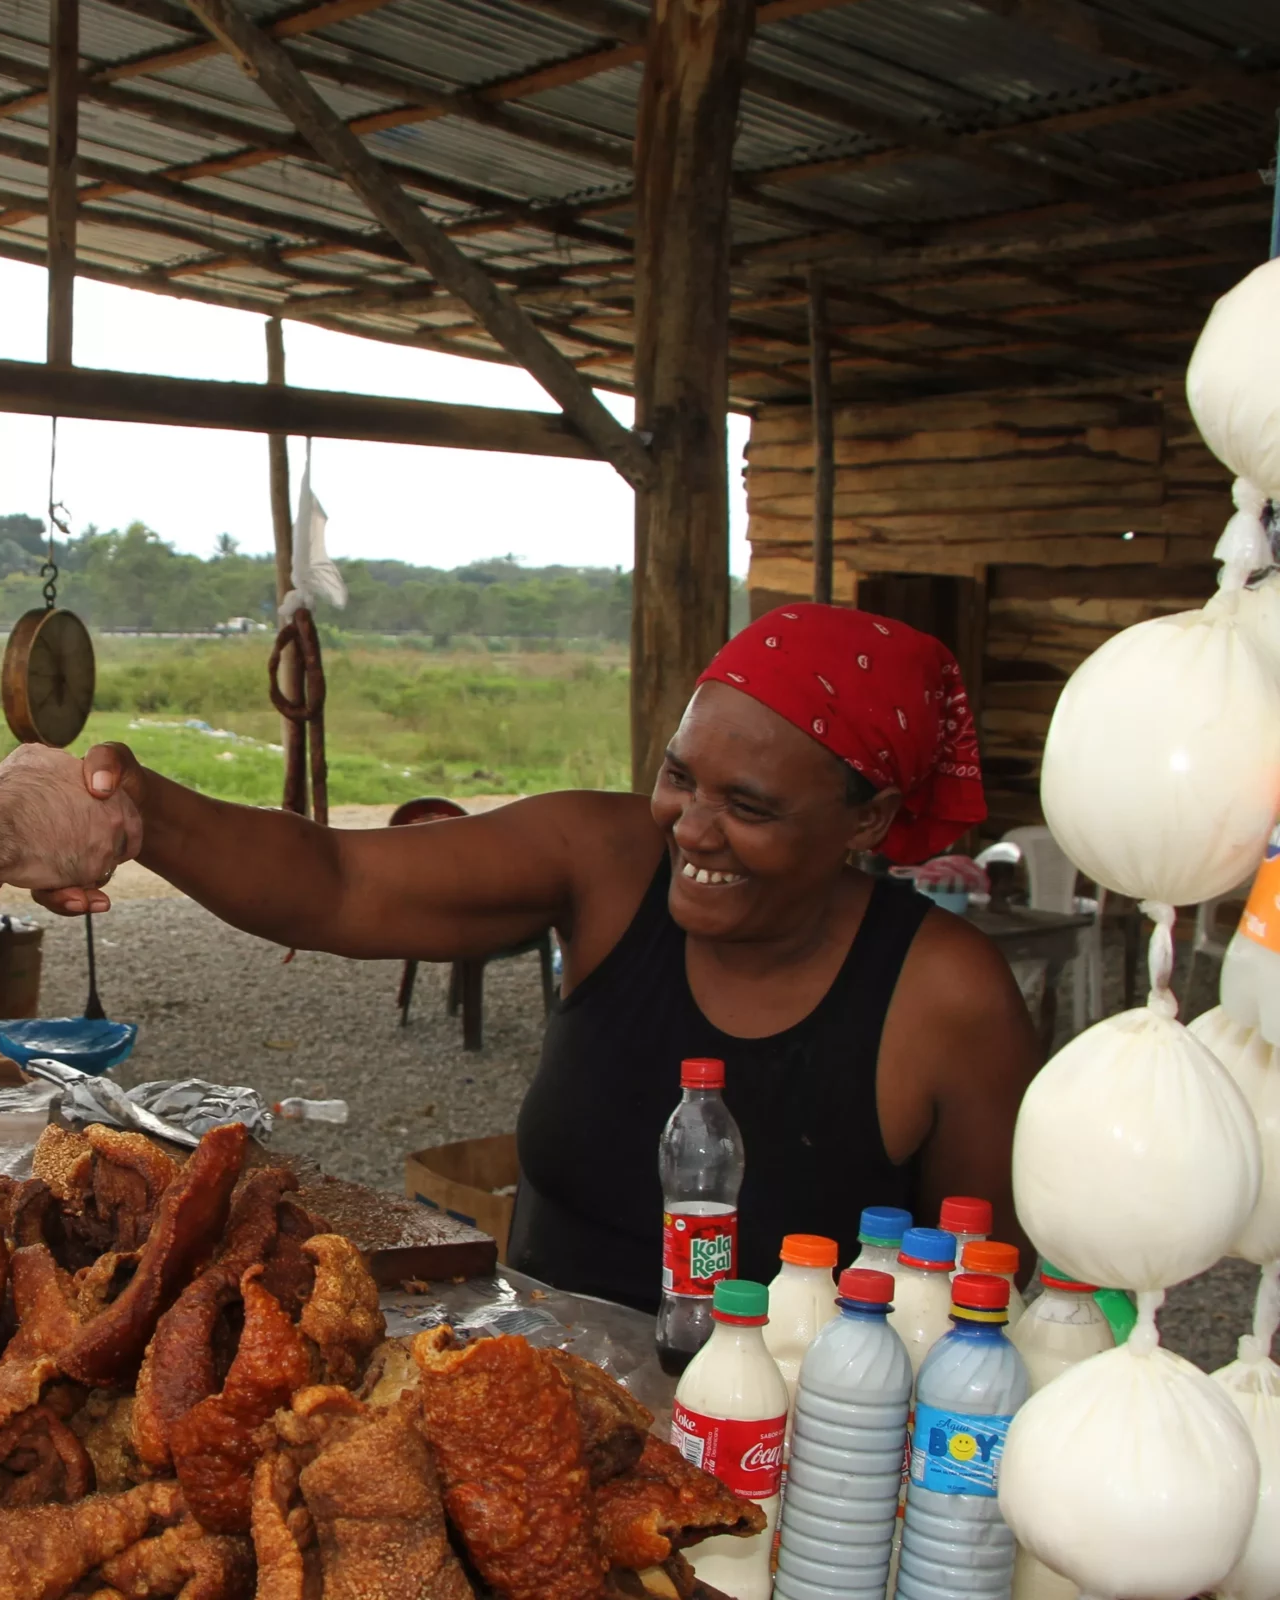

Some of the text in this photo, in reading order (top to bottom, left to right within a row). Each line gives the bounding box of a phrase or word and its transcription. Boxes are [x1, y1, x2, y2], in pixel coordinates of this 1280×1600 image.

[690, 1235, 731, 1260] Kola
[690, 1252, 731, 1279] Real
[675, 1408, 696, 1431] Coke
[936, 1419, 970, 1433] Agua
[760, 1430, 779, 1440] SABOR
[928, 1427, 999, 1463] BOY
